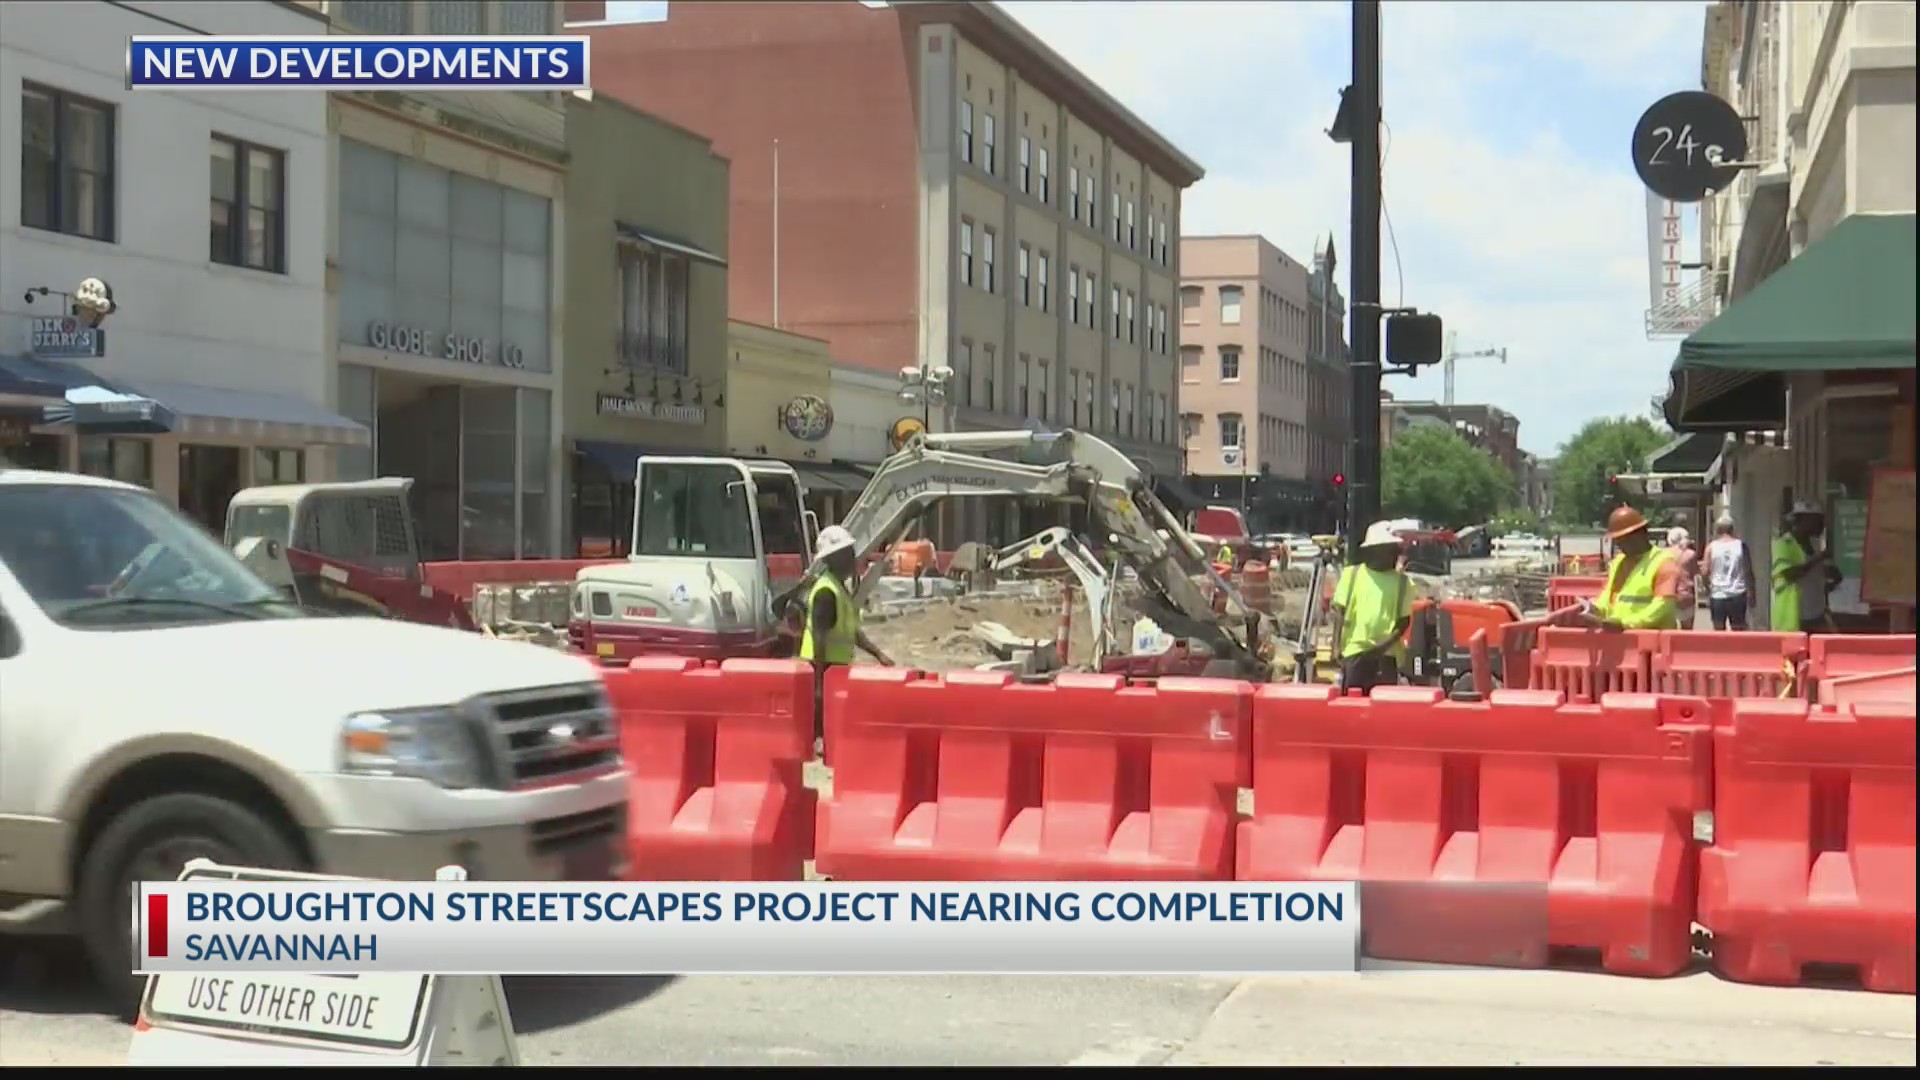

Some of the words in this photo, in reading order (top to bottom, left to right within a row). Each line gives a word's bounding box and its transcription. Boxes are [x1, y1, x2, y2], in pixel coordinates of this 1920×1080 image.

[371, 320, 433, 357] GLOBE
[445, 333, 491, 364] SHOE
[187, 976, 234, 1013] USE
[240, 981, 316, 1022] OTHER
[322, 990, 380, 1031] SIDE
